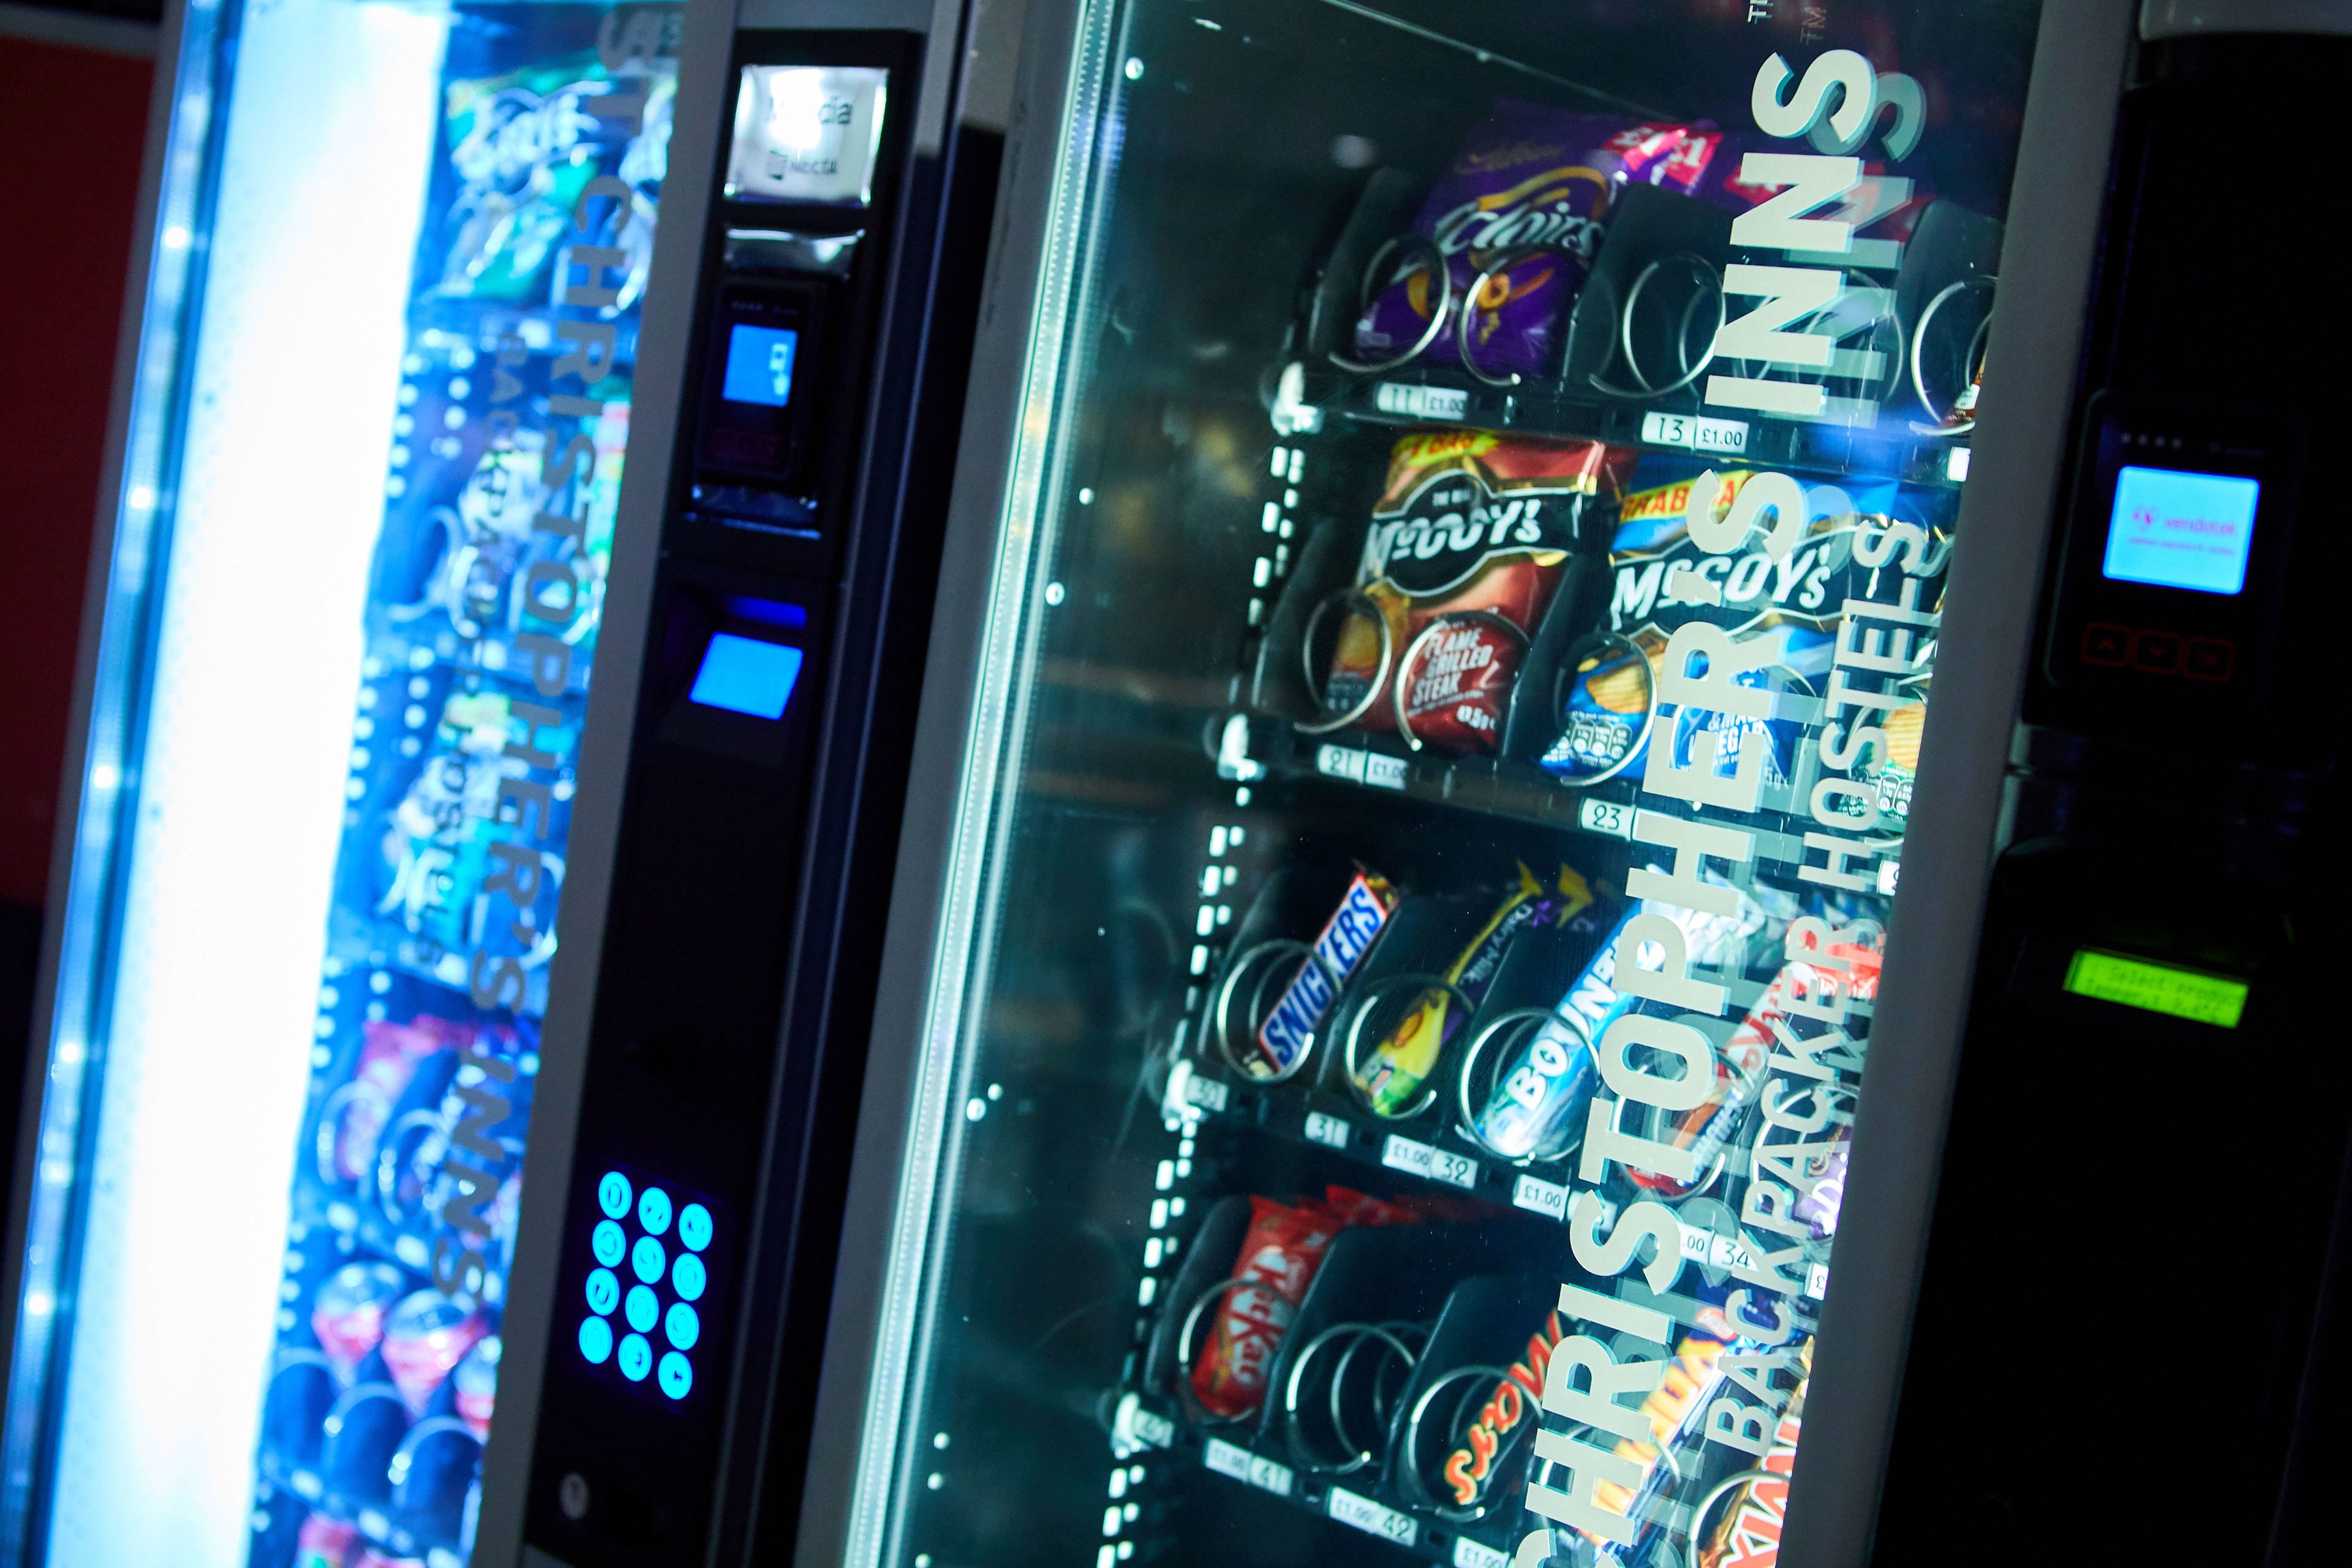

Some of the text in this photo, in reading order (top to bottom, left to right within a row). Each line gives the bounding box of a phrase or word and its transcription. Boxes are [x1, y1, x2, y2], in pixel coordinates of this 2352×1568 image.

[1705, 49, 1874, 415] INNS
[1659, 417, 1684, 442] 13
[1703, 428, 1743, 447] £1.00
[1412, 671, 1463, 707] STEAK
[1593, 804, 1621, 831] 23
[1265, 888, 1381, 1068] SNICKERS
[1705, 916, 1850, 1457] BACKPACKER
[1798, 519, 1924, 893] HOSTELS
[434, 1049, 516, 1306] INNS
[1440, 1155, 1469, 1185] 32
[1525, 1185, 1561, 1208] £1.00
[1722, 1242, 1751, 1267] 34
